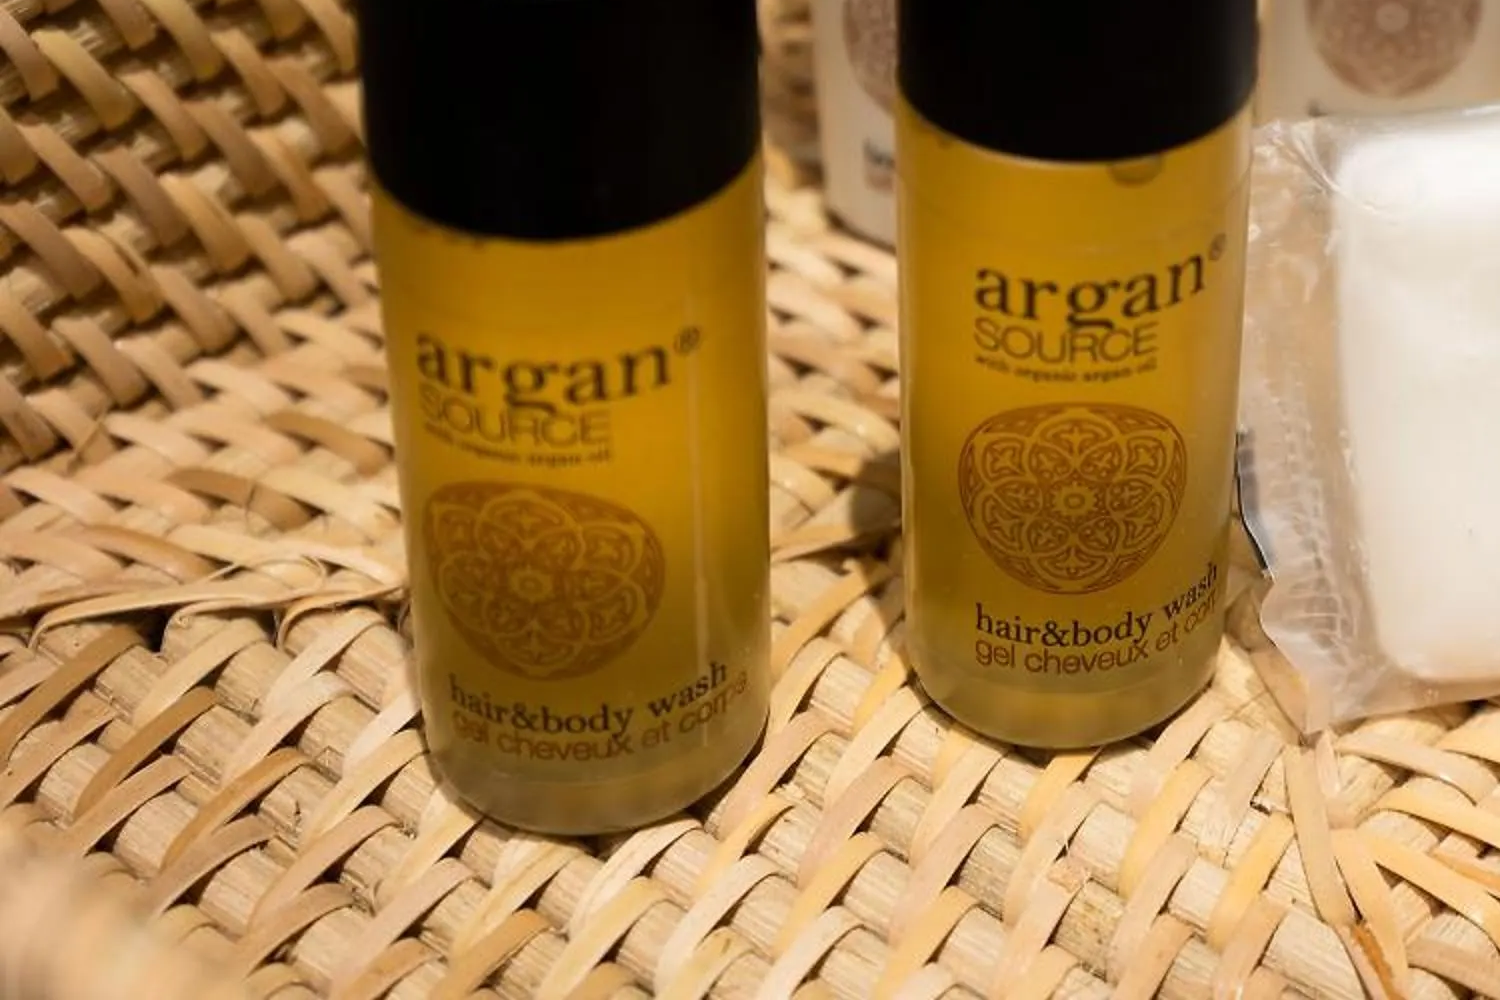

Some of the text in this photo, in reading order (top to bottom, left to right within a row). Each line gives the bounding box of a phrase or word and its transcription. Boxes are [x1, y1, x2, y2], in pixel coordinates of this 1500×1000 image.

[974, 315, 1160, 364] SOURCE
[975, 602, 1154, 648] hair&body
[975, 588, 1217, 675] gel cheveux et cor
[449, 661, 727, 741] hair&body wash
[496, 731, 635, 762] cheveux
[641, 717, 672, 748] et
